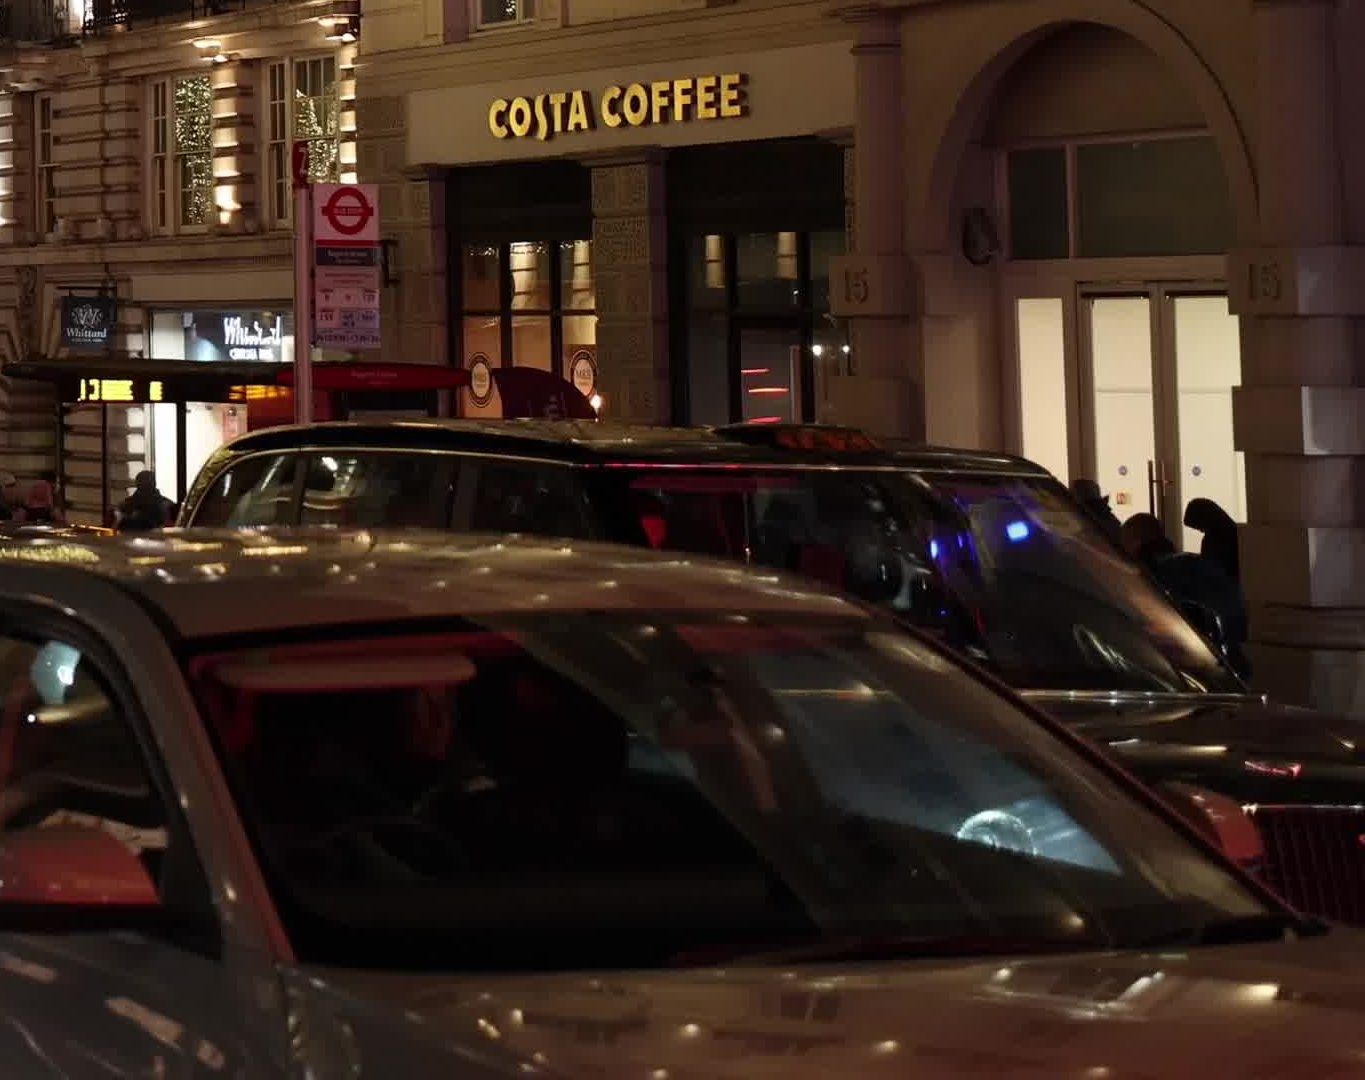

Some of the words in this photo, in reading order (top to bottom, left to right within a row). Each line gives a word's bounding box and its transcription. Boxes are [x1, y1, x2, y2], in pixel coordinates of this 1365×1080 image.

[488, 89, 591, 141] COSTA
[601, 73, 742, 128] COFFEE
[67, 327, 107, 339] Whittard
